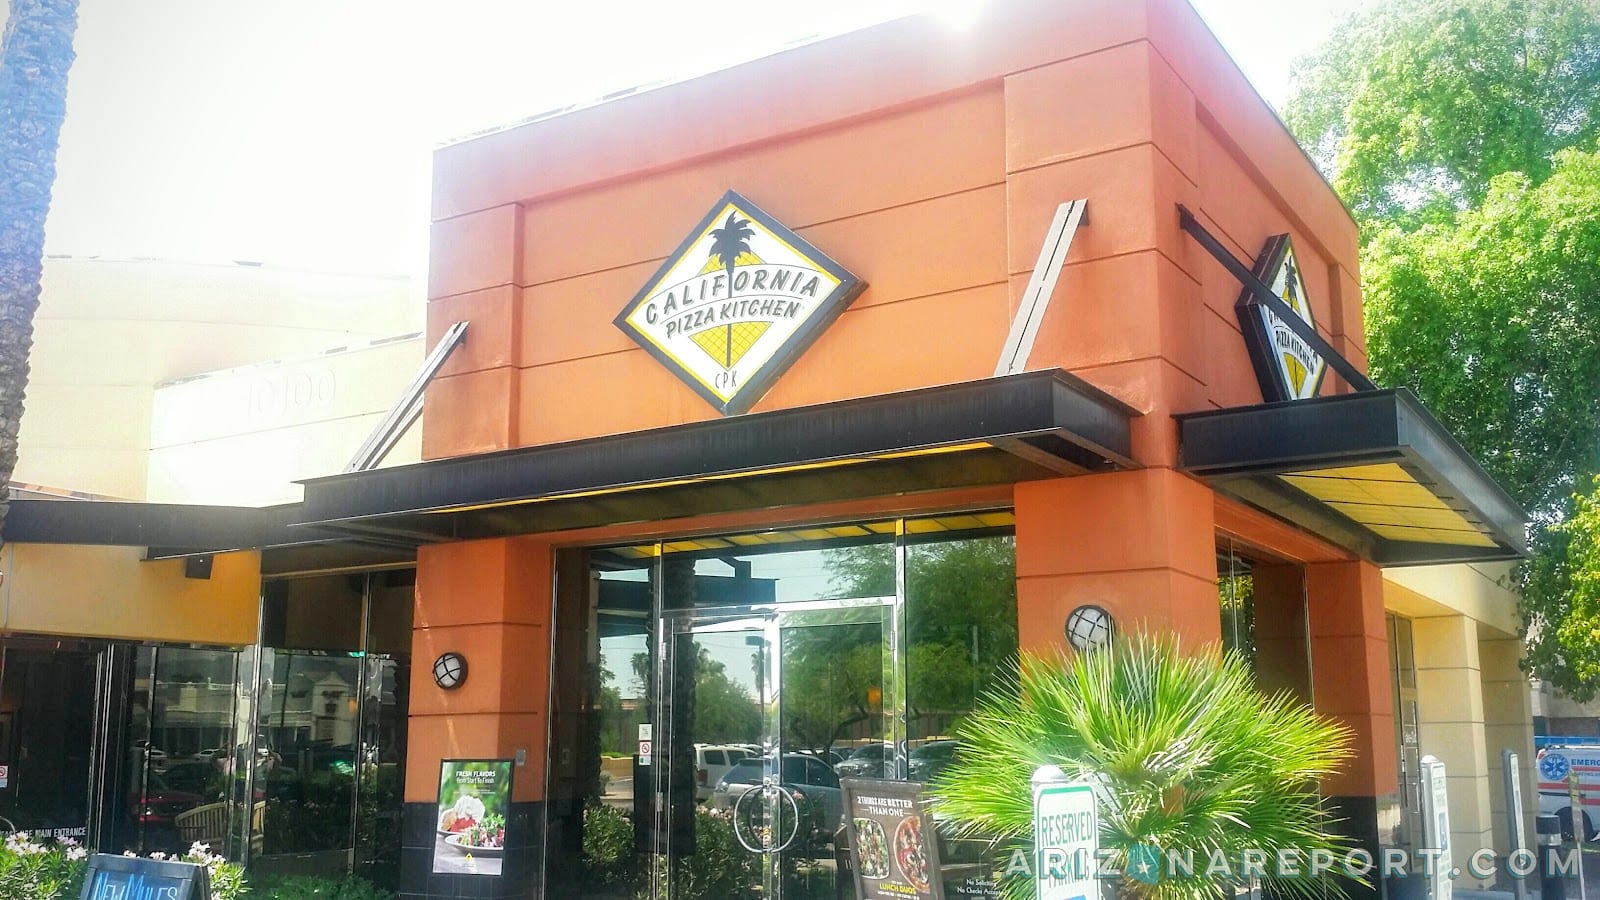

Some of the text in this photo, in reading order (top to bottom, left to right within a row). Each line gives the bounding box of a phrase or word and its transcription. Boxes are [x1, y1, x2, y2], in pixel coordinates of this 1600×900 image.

[646, 268, 820, 326] CALIFORNIA
[665, 298, 802, 339] PIZZA KITCHEN
[1275, 330, 1290, 349] PIZZA
[715, 371, 738, 389] CPK
[869, 806, 904, 817] THAN ONE
[888, 799, 913, 808] BETTER
[53, 827, 87, 838] ENTRANCE
[1041, 811, 1093, 847] RESERVED
[880, 882, 899, 892] LUNCH
